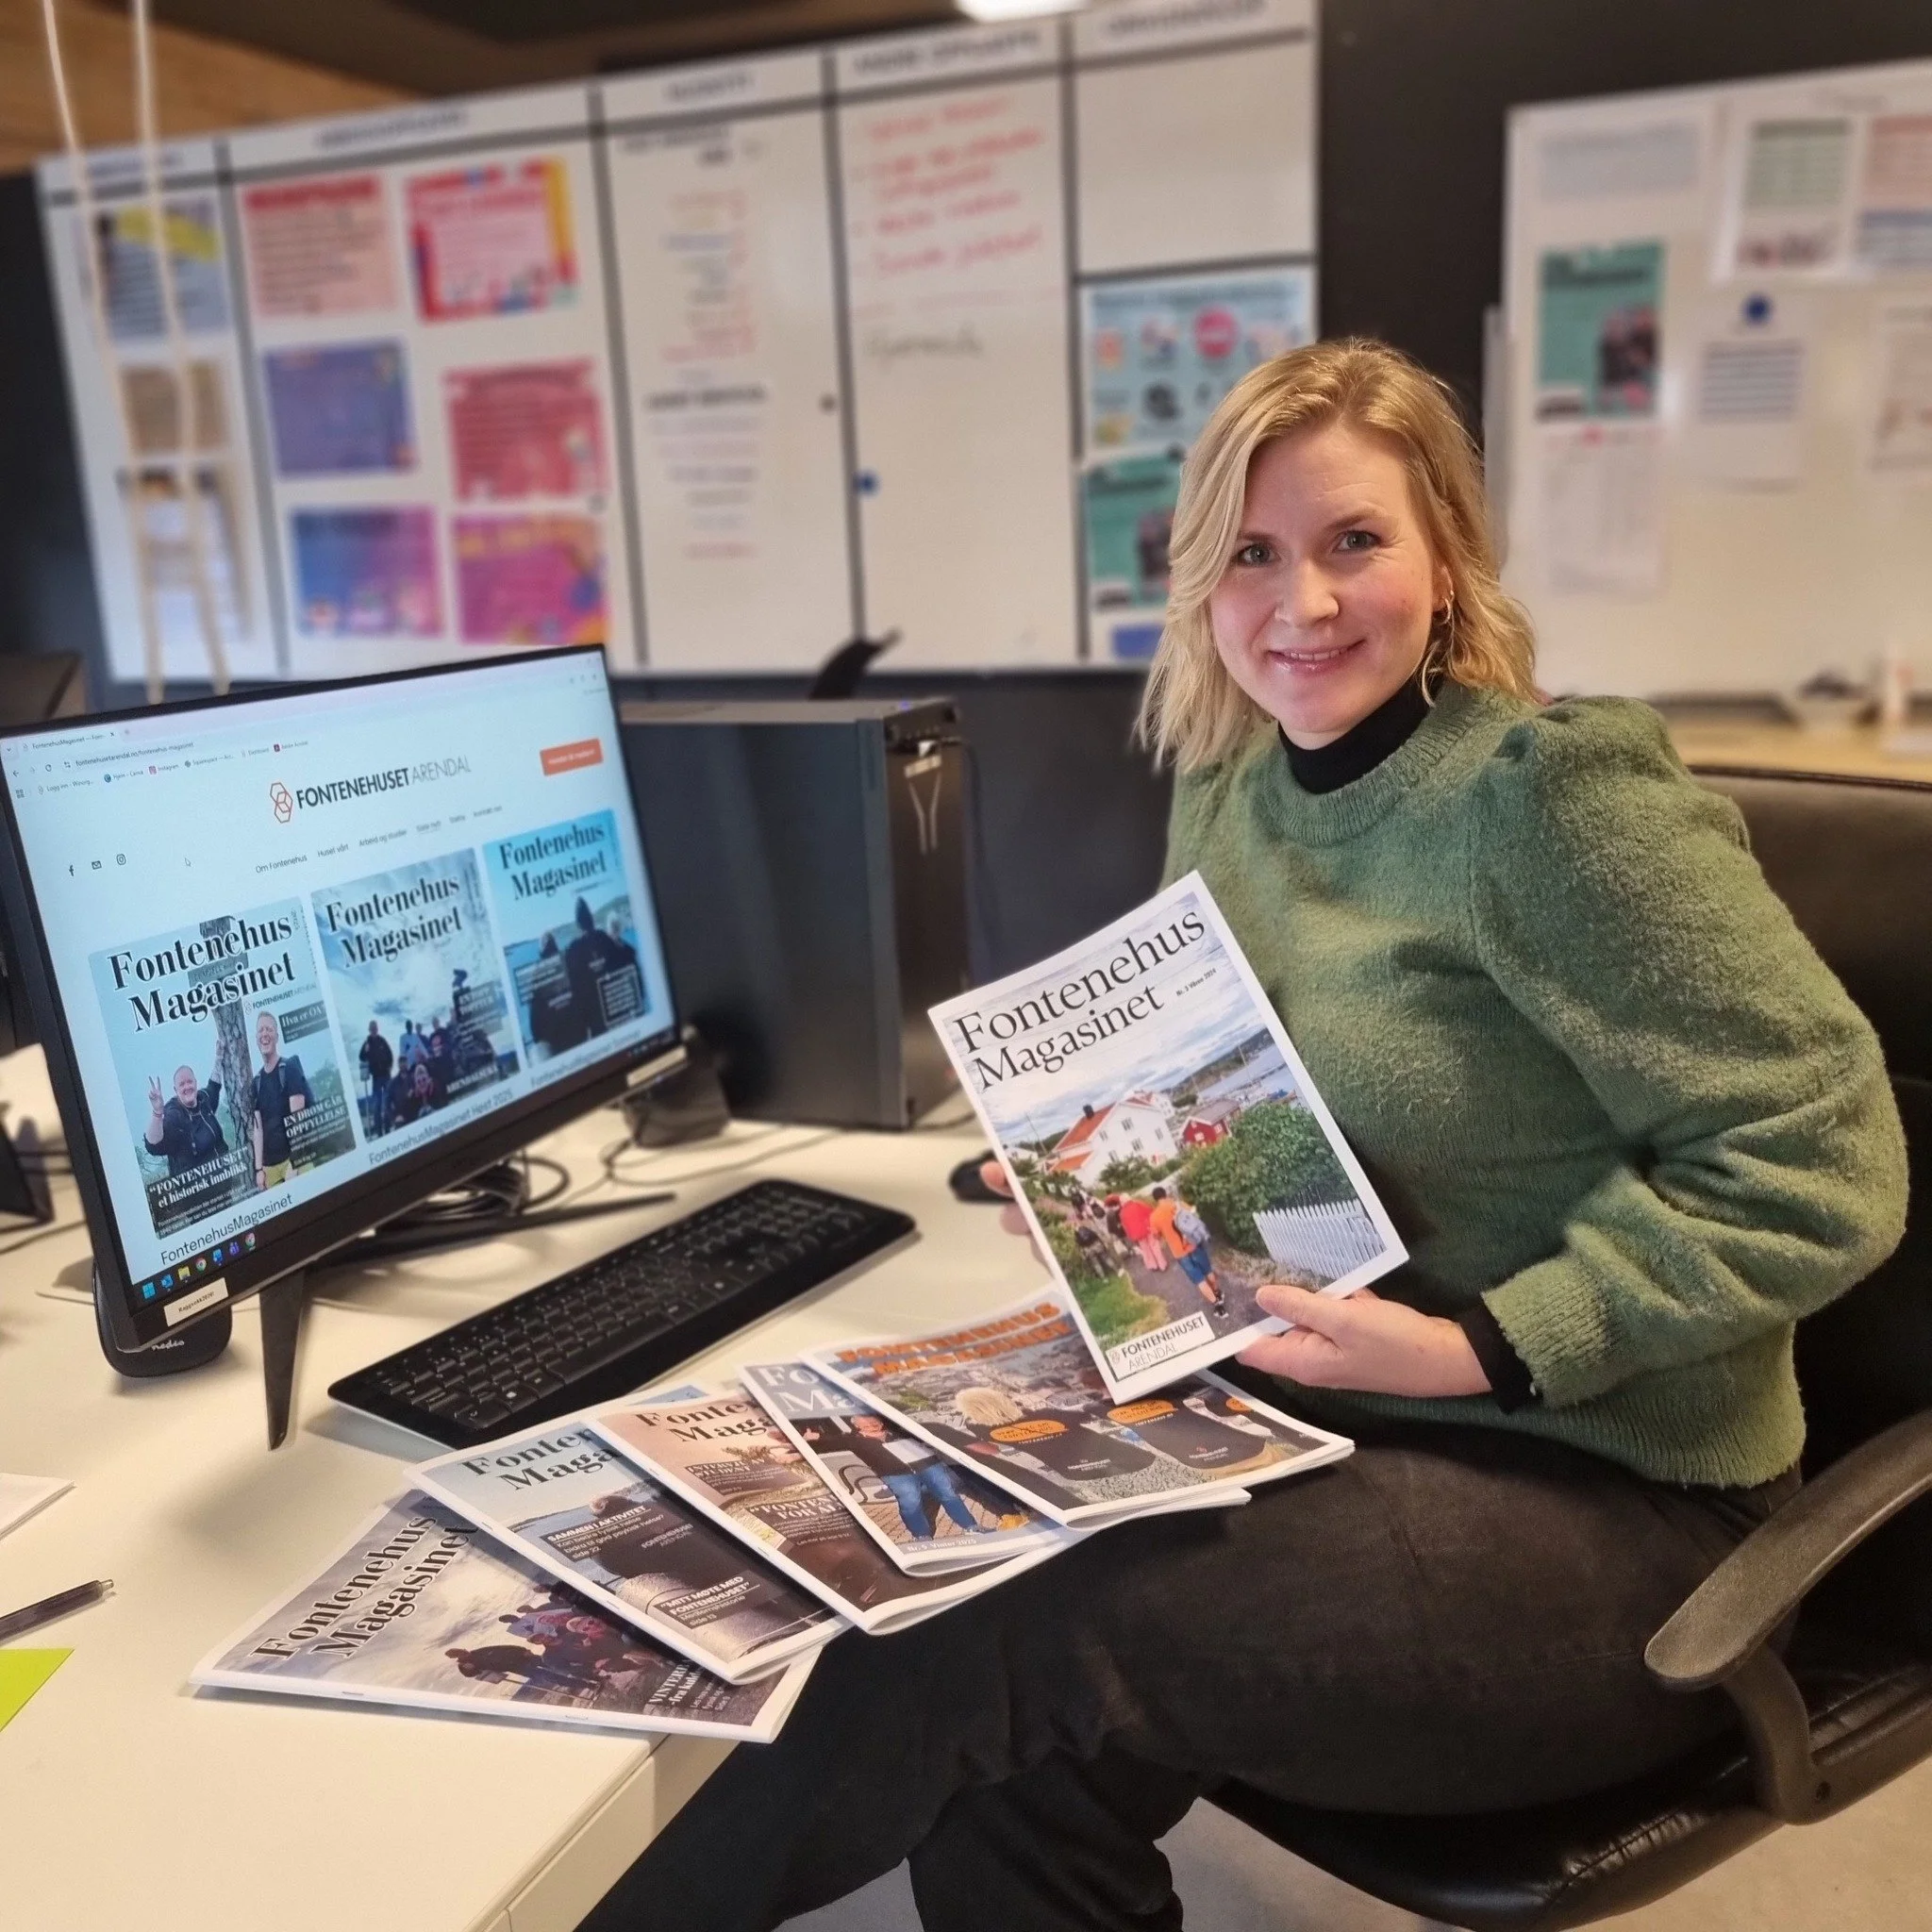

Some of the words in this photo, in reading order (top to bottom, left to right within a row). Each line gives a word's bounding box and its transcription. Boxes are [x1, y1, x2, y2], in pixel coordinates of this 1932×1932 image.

[296, 767, 410, 809] FONTENEHUSET
[410, 754, 472, 786] ARENDAL
[255, 862, 269, 874] Om
[269, 854, 308, 871] Fontenehus
[317, 845, 336, 858] Huset
[358, 836, 379, 848] Arbeid
[498, 822, 605, 871] Fontenehus
[510, 851, 607, 900] Magasinet
[325, 875, 460, 933] Fontenehus
[107, 915, 294, 991] Fontenehus
[340, 907, 462, 968] Magasinet
[128, 951, 296, 1033] Magasinet
[953, 910, 1206, 1054] Fontenehus
[972, 985, 1165, 1091] Magasinet
[284, 1113, 297, 1127] EN
[169, 1179, 209, 1204] historisk
[208, 1162, 248, 1186] innblikk
[159, 1192, 293, 1265] FontenehusMagasinet
[1121, 1316, 1205, 1358] FONTENEHUSET
[1127, 1342, 1178, 1371] ARENDAL
[547, 1520, 593, 1542] SAMMEN
[598, 1505, 647, 1526] AKTIVITET
[778, 1508, 819, 1522] FOR
[247, 1515, 438, 1660] Fontenehus
[308, 1524, 479, 1658] Magasinet
[690, 1584, 720, 1603] MØTE
[718, 1575, 744, 1591] MED
